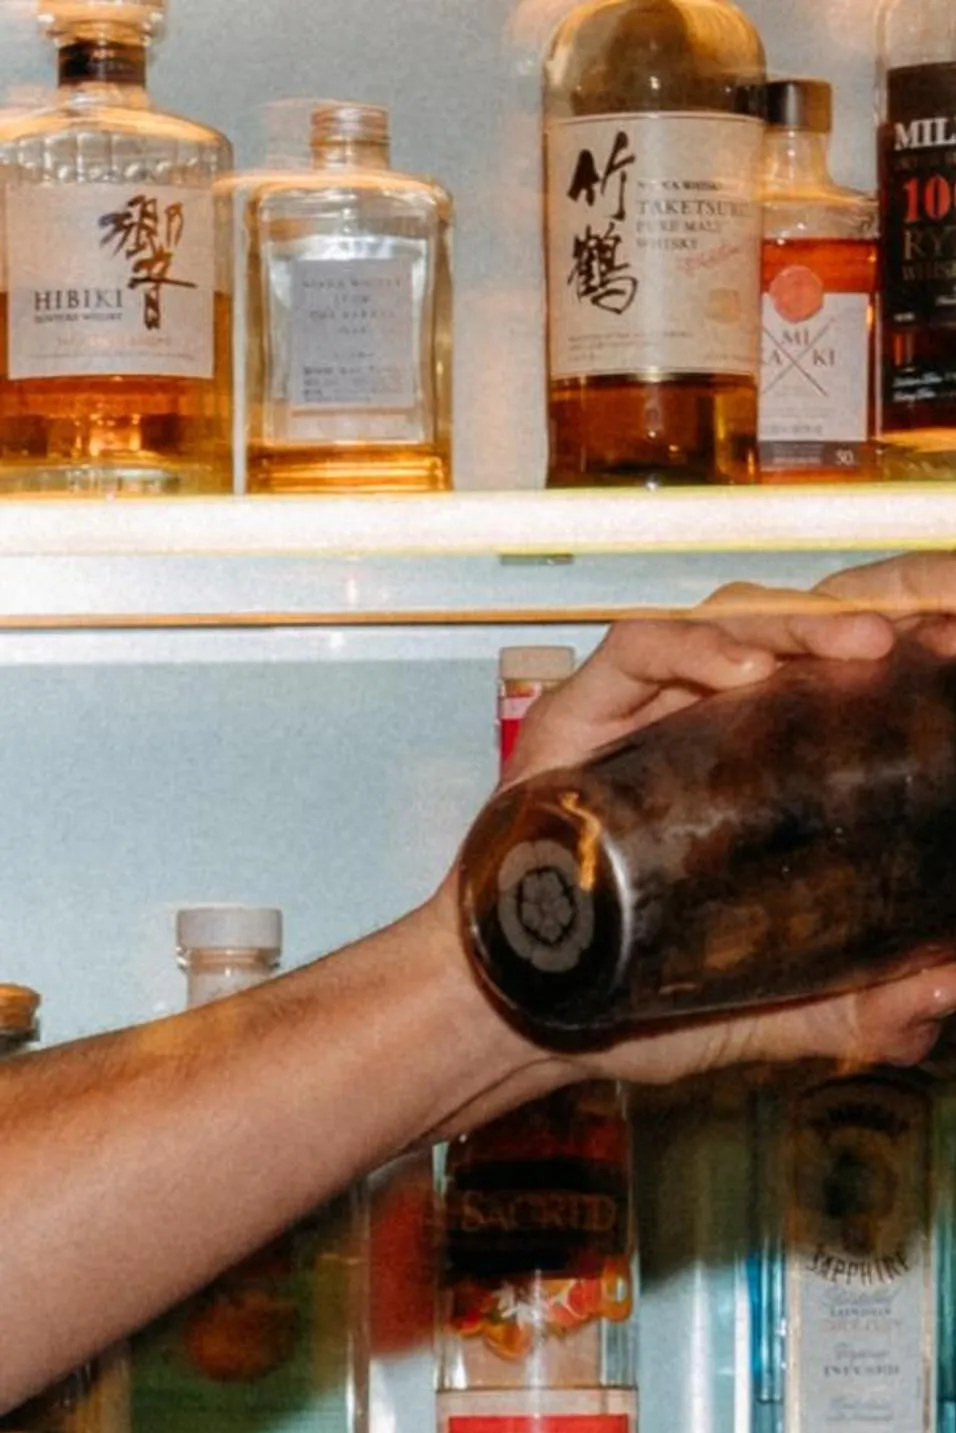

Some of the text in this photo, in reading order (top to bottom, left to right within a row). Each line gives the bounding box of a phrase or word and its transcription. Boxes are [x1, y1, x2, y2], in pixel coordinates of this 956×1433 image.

[566, 131, 638, 316] 竹鶴
[34, 288, 124, 311] HIBIKI
[812, 348, 836, 368] KI
